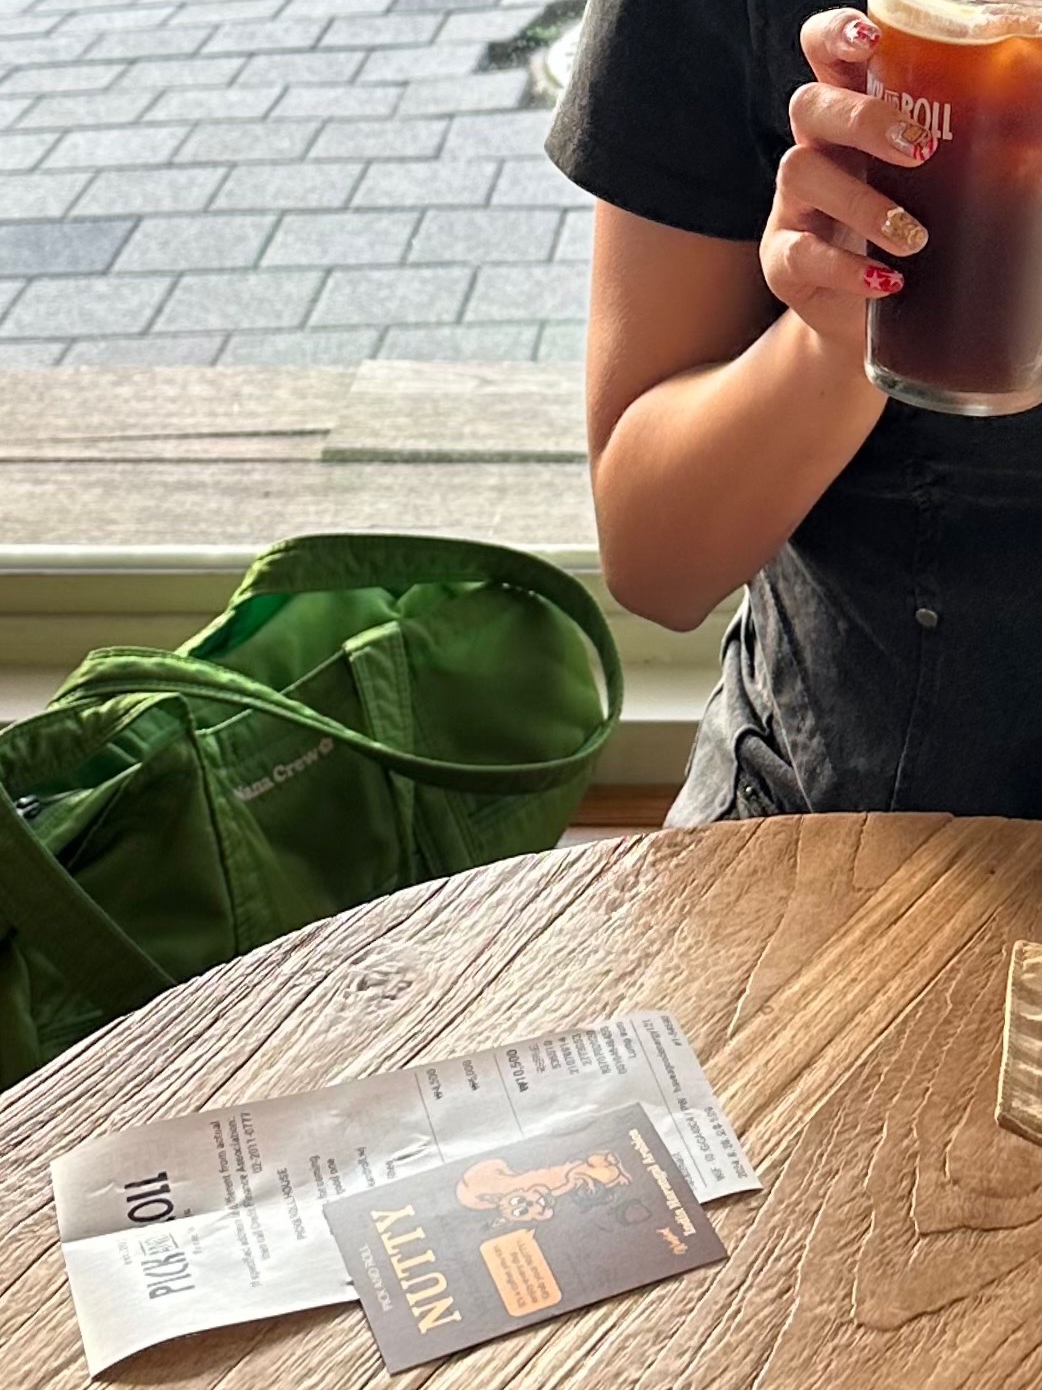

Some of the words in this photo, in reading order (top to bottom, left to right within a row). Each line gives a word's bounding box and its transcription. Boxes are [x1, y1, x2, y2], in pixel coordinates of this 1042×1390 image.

[506, 1049, 528, 1091] ₩10,500
[209, 1120, 225, 1149] actual
[216, 1150, 230, 1172] from
[124, 1170, 176, 1230] OLL
[673, 1208, 695, 1235] India
[140, 1252, 194, 1298] PICK
[371, 1202, 461, 1332] NUTTY
